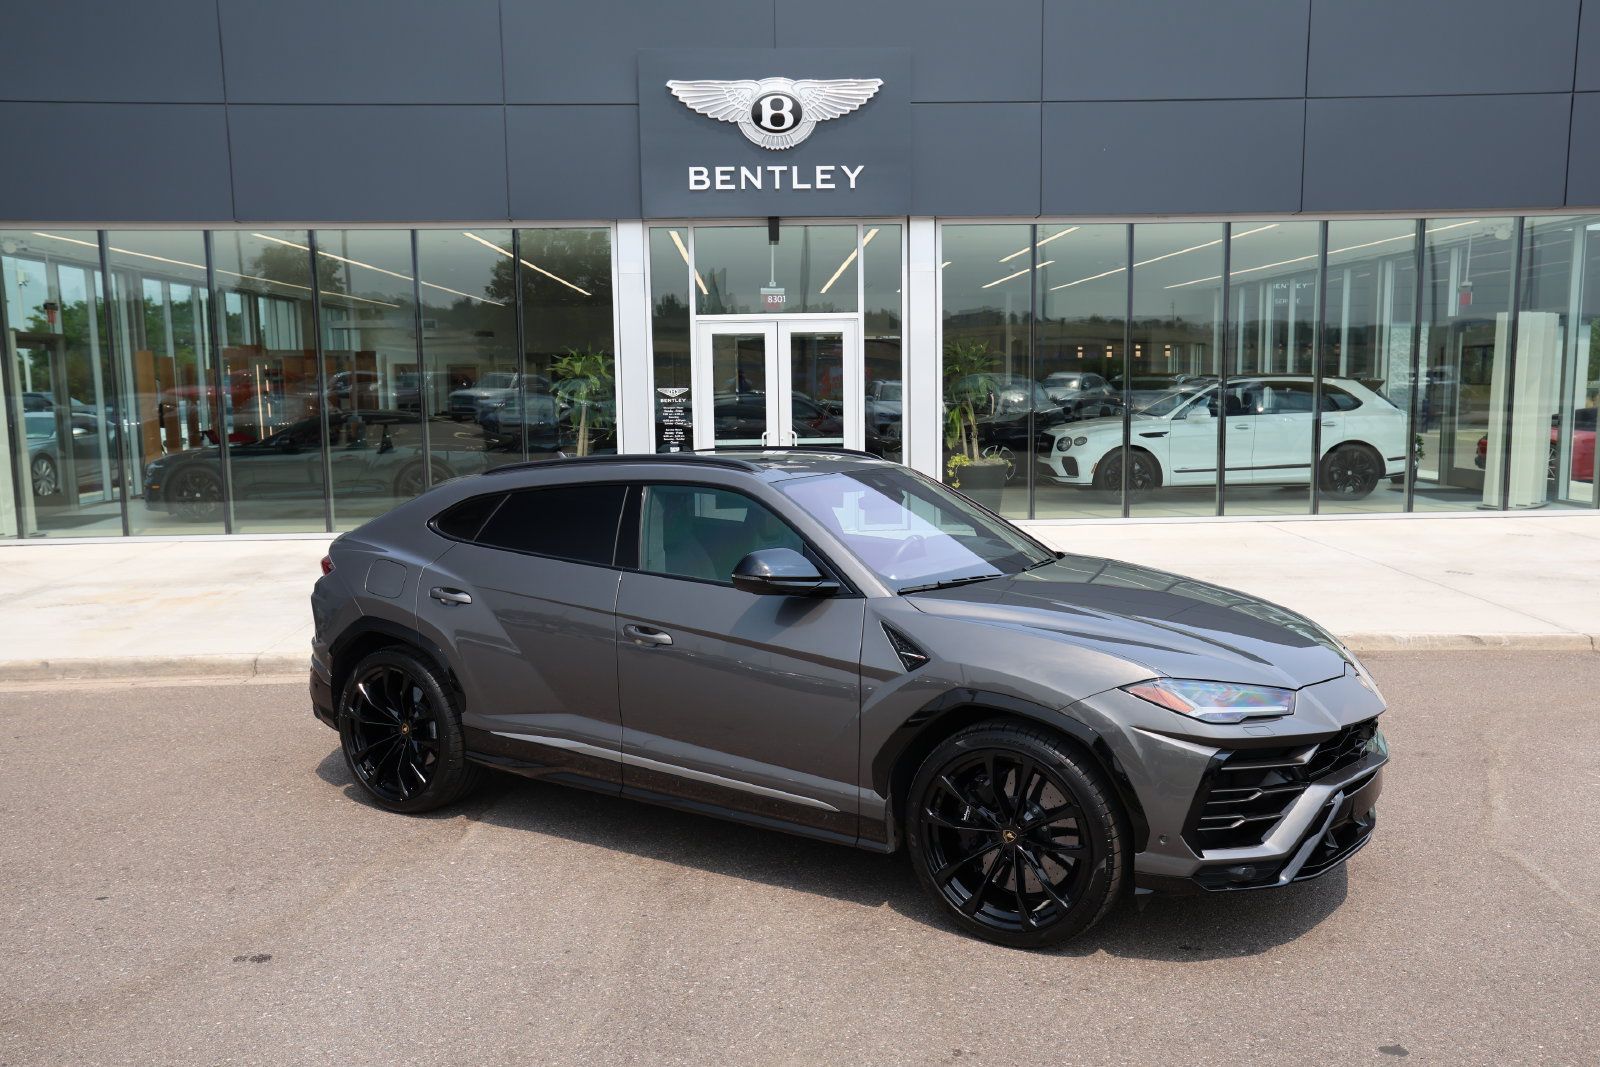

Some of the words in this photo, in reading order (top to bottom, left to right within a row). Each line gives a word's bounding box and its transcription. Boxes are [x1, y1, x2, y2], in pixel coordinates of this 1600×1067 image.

[761, 95, 794, 130] B
[688, 165, 865, 190] BENTLEY
[767, 295, 786, 303] 8301
